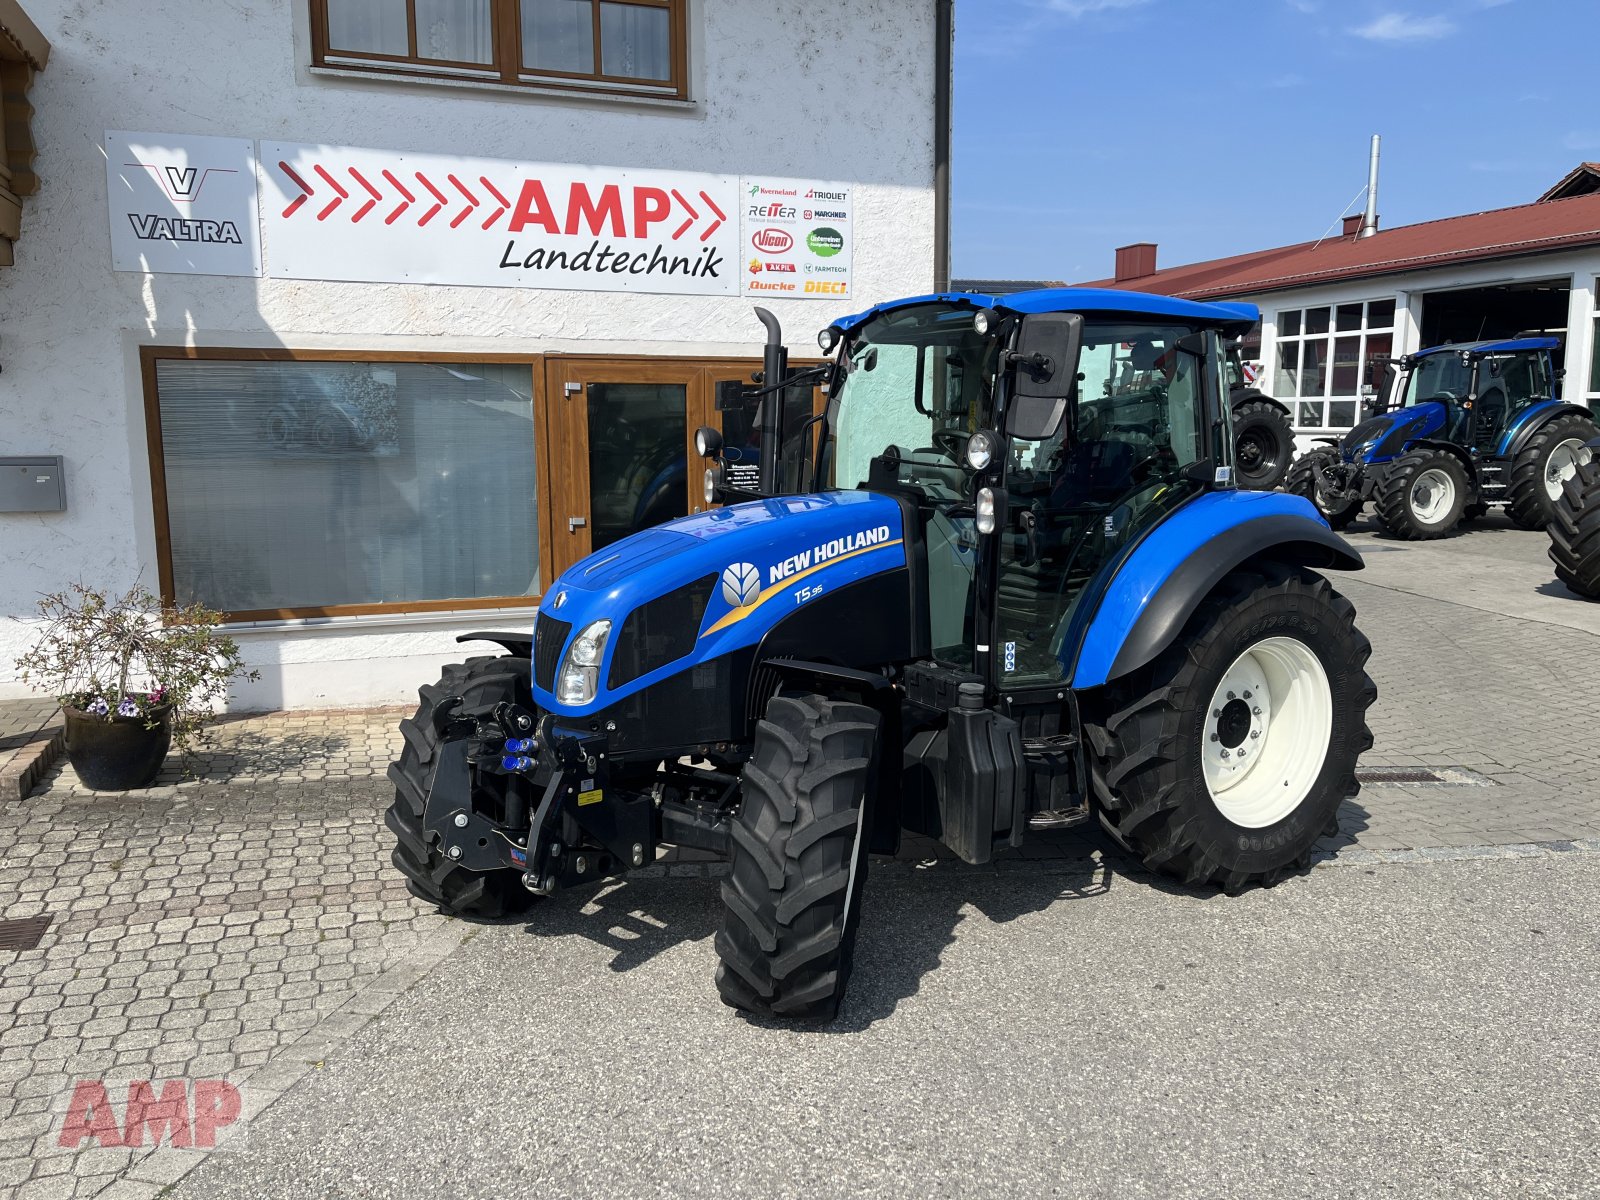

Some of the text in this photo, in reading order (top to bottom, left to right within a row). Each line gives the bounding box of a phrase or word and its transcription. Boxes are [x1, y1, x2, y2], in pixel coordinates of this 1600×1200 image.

[760, 187, 797, 196] Kverneland
[814, 191, 847, 200] TRIOLIET
[507, 179, 671, 239] AMP
[748, 203, 797, 218] REITER
[814, 210, 847, 219] MARCHNER
[127, 213, 242, 244] VALTRA
[758, 230, 788, 247] Vicon
[499, 239, 724, 278] Landtechnik
[814, 265, 847, 273] FARMTECH
[749, 280, 796, 291] Quicke
[769, 525, 890, 584] NEW HOLLAND
